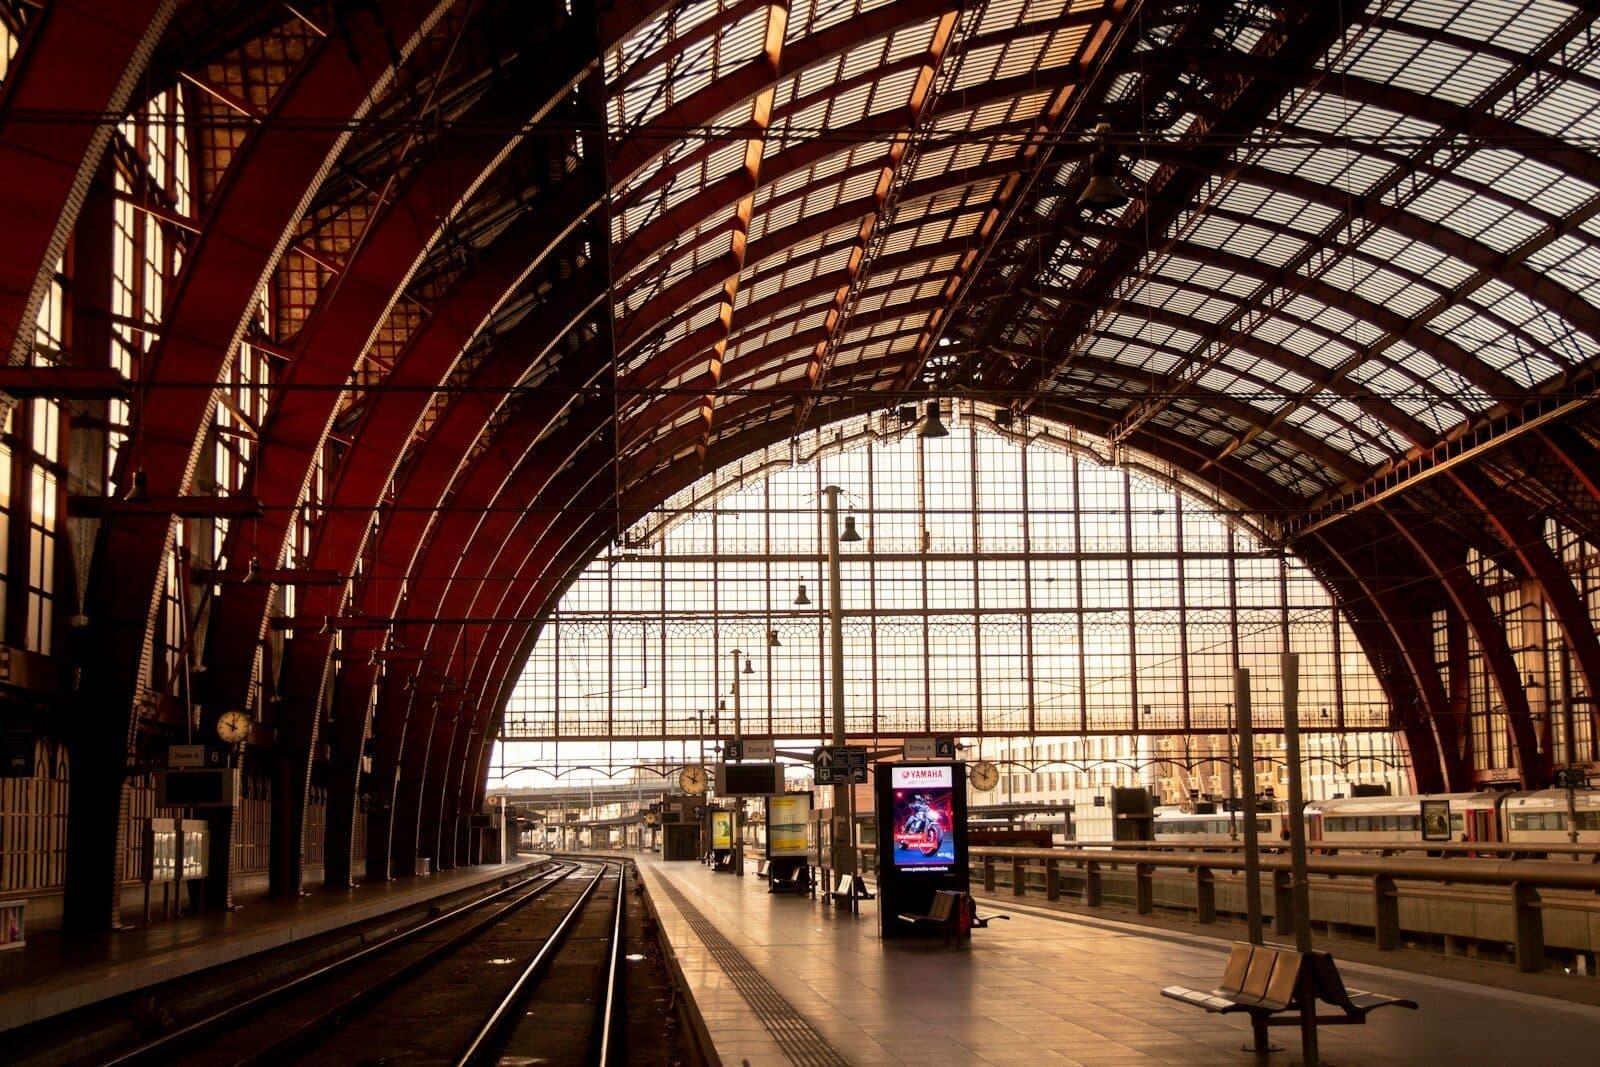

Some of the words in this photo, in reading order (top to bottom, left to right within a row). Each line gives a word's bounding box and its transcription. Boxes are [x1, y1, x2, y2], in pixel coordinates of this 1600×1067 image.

[730, 746, 738, 756] 5
[941, 743, 948, 754] 4
[211, 751, 219, 762] 6
[911, 770, 943, 778] YAMAHA
